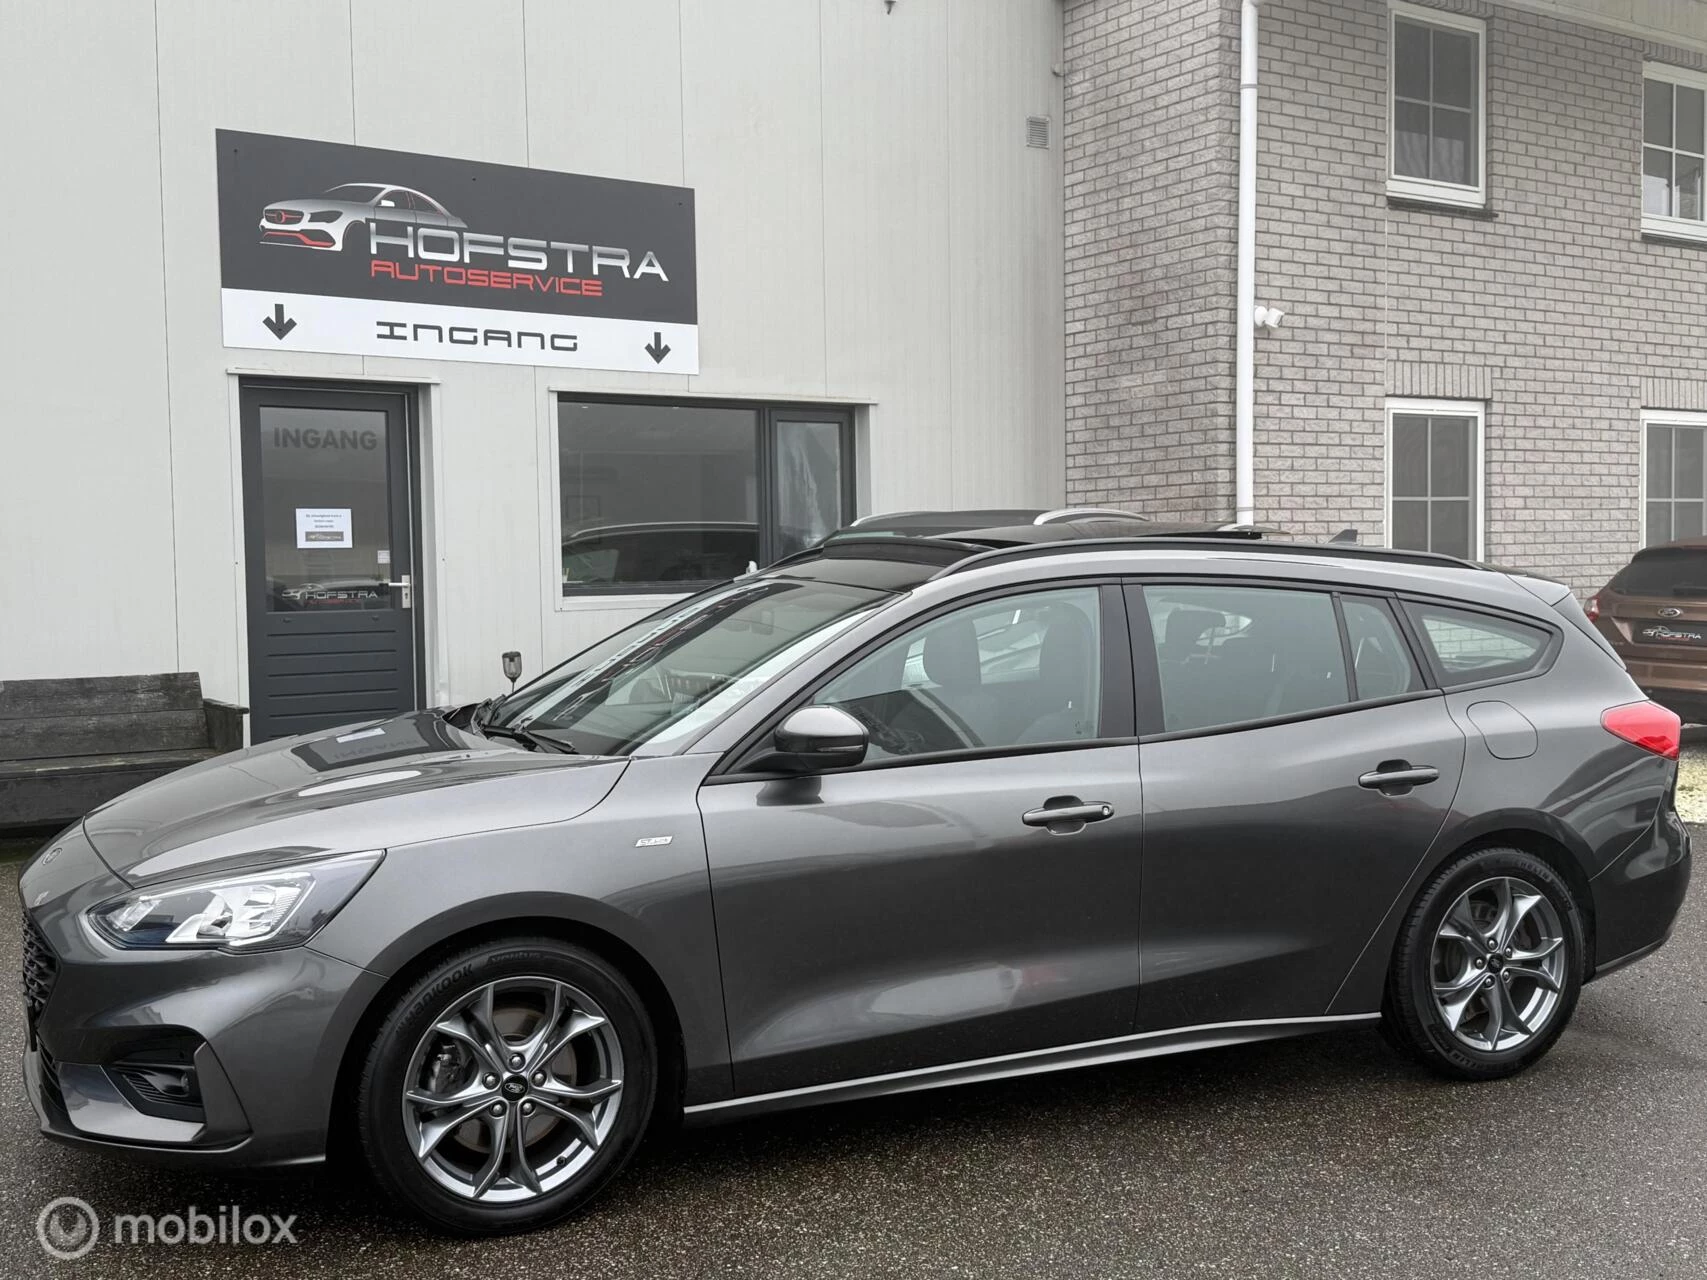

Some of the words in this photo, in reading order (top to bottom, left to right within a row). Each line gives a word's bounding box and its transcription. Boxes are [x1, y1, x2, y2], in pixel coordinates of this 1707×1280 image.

[370, 222, 669, 282] HOFSTRA
[371, 260, 603, 297] AUTOSERVICE
[376, 321, 578, 352] INGANG
[274, 427, 378, 451] INGANG
[305, 591, 378, 599] HOFSTRA
